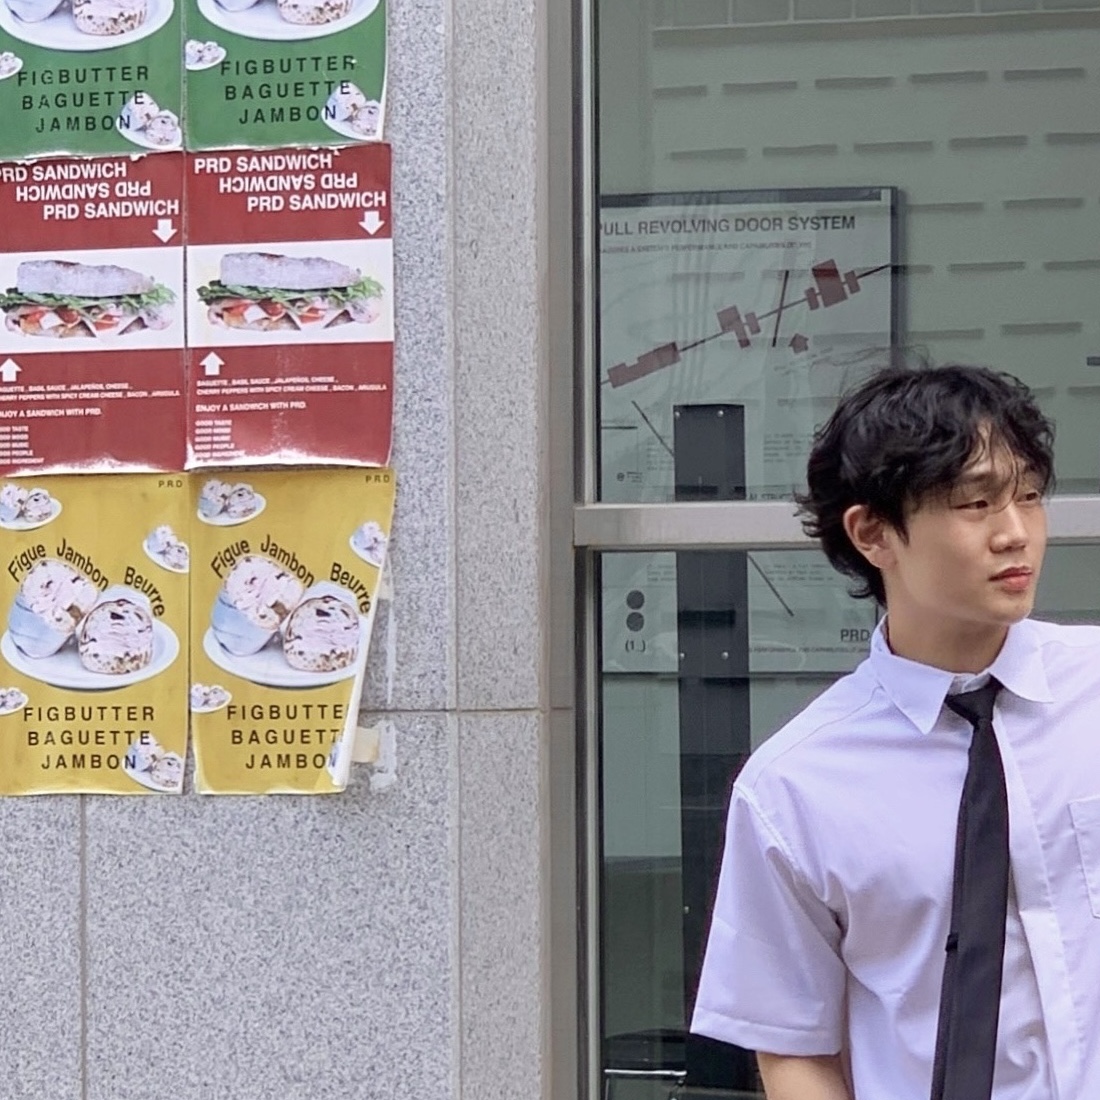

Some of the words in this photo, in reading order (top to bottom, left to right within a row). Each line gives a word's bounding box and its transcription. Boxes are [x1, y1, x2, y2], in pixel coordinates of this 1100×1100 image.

[221, 55, 356, 76] FIGBUTTER
[18, 66, 148, 86] FIGBUTTER
[225, 80, 351, 100] BAGUETTE
[22, 90, 145, 110] BAGUETTE
[36, 115, 130, 133] JAMBON
[239, 105, 336, 124] JAMBON
[0, 167, 28, 182] RD
[32, 162, 126, 181] SANDWICH
[194, 157, 232, 174] PRD
[236, 154, 332, 172] SANDWICH
[116, 180, 151, 198] PRD
[219, 174, 315, 193] SANDWICH
[321, 172, 358, 189] PRD
[16, 183, 110, 201] SANDWICH
[247, 196, 284, 212] PRD
[289, 191, 386, 210] SANDWICH
[44, 204, 80, 220] PRD
[84, 199, 179, 218] SANDWICH
[638, 219, 730, 234] REVOLVING
[734, 217, 783, 233] DOOR
[788, 216, 856, 231] SYSTEM
[158, 480, 183, 488] PRD
[8, 544, 47, 582] Figue
[56, 538, 110, 592] Jambon
[124, 566, 166, 617] Beurre
[210, 540, 250, 579] Figue
[260, 534, 315, 588] Jambon
[330, 562, 372, 614] Beurre
[24, 706, 154, 722] FIGBUTTER
[227, 704, 348, 720] FIGBUTTE
[28, 730, 150, 746] BAGUETTE
[231, 729, 346, 744] BAGUETT
[42, 754, 136, 770] JAMBON
